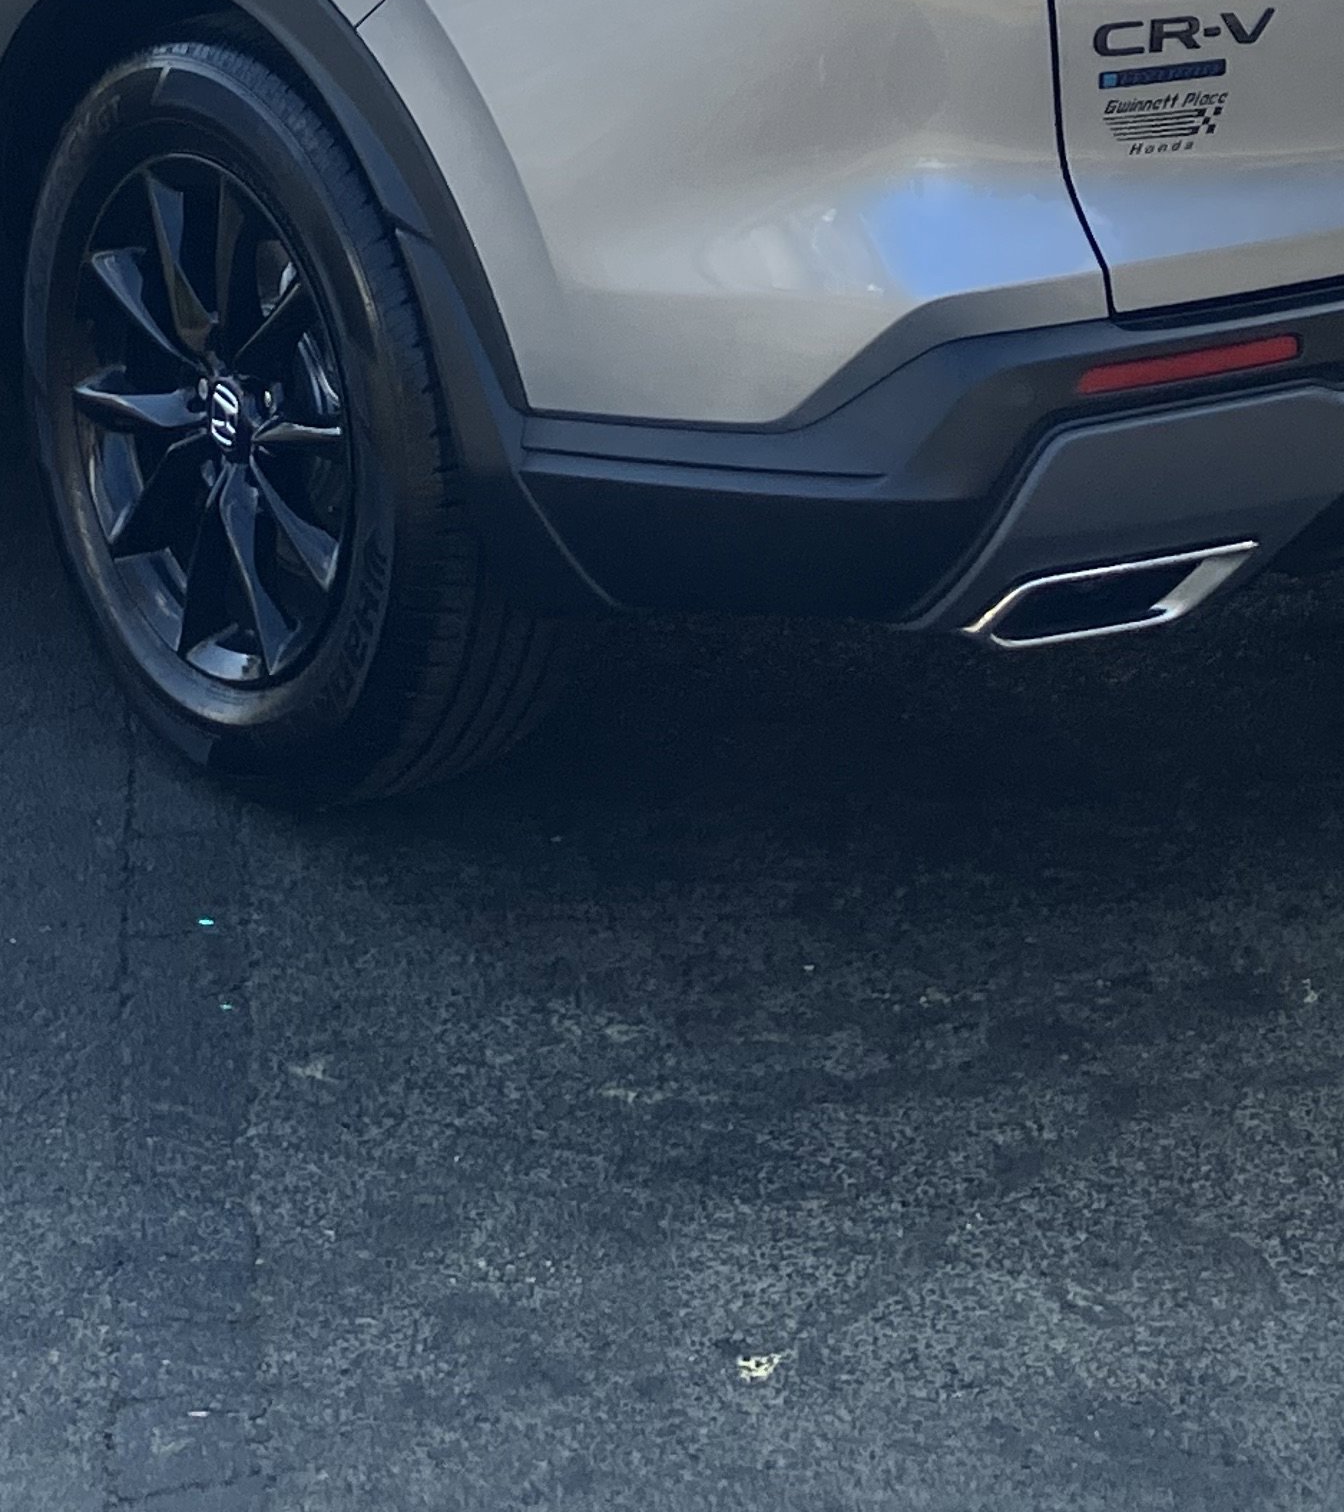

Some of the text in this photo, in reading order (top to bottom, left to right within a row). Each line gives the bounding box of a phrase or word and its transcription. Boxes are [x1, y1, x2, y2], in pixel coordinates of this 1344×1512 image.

[1093, 7, 1275, 56] CR-V
[1104, 91, 1229, 115] Gwinnett Place
[1129, 140, 1194, 155] Honda
